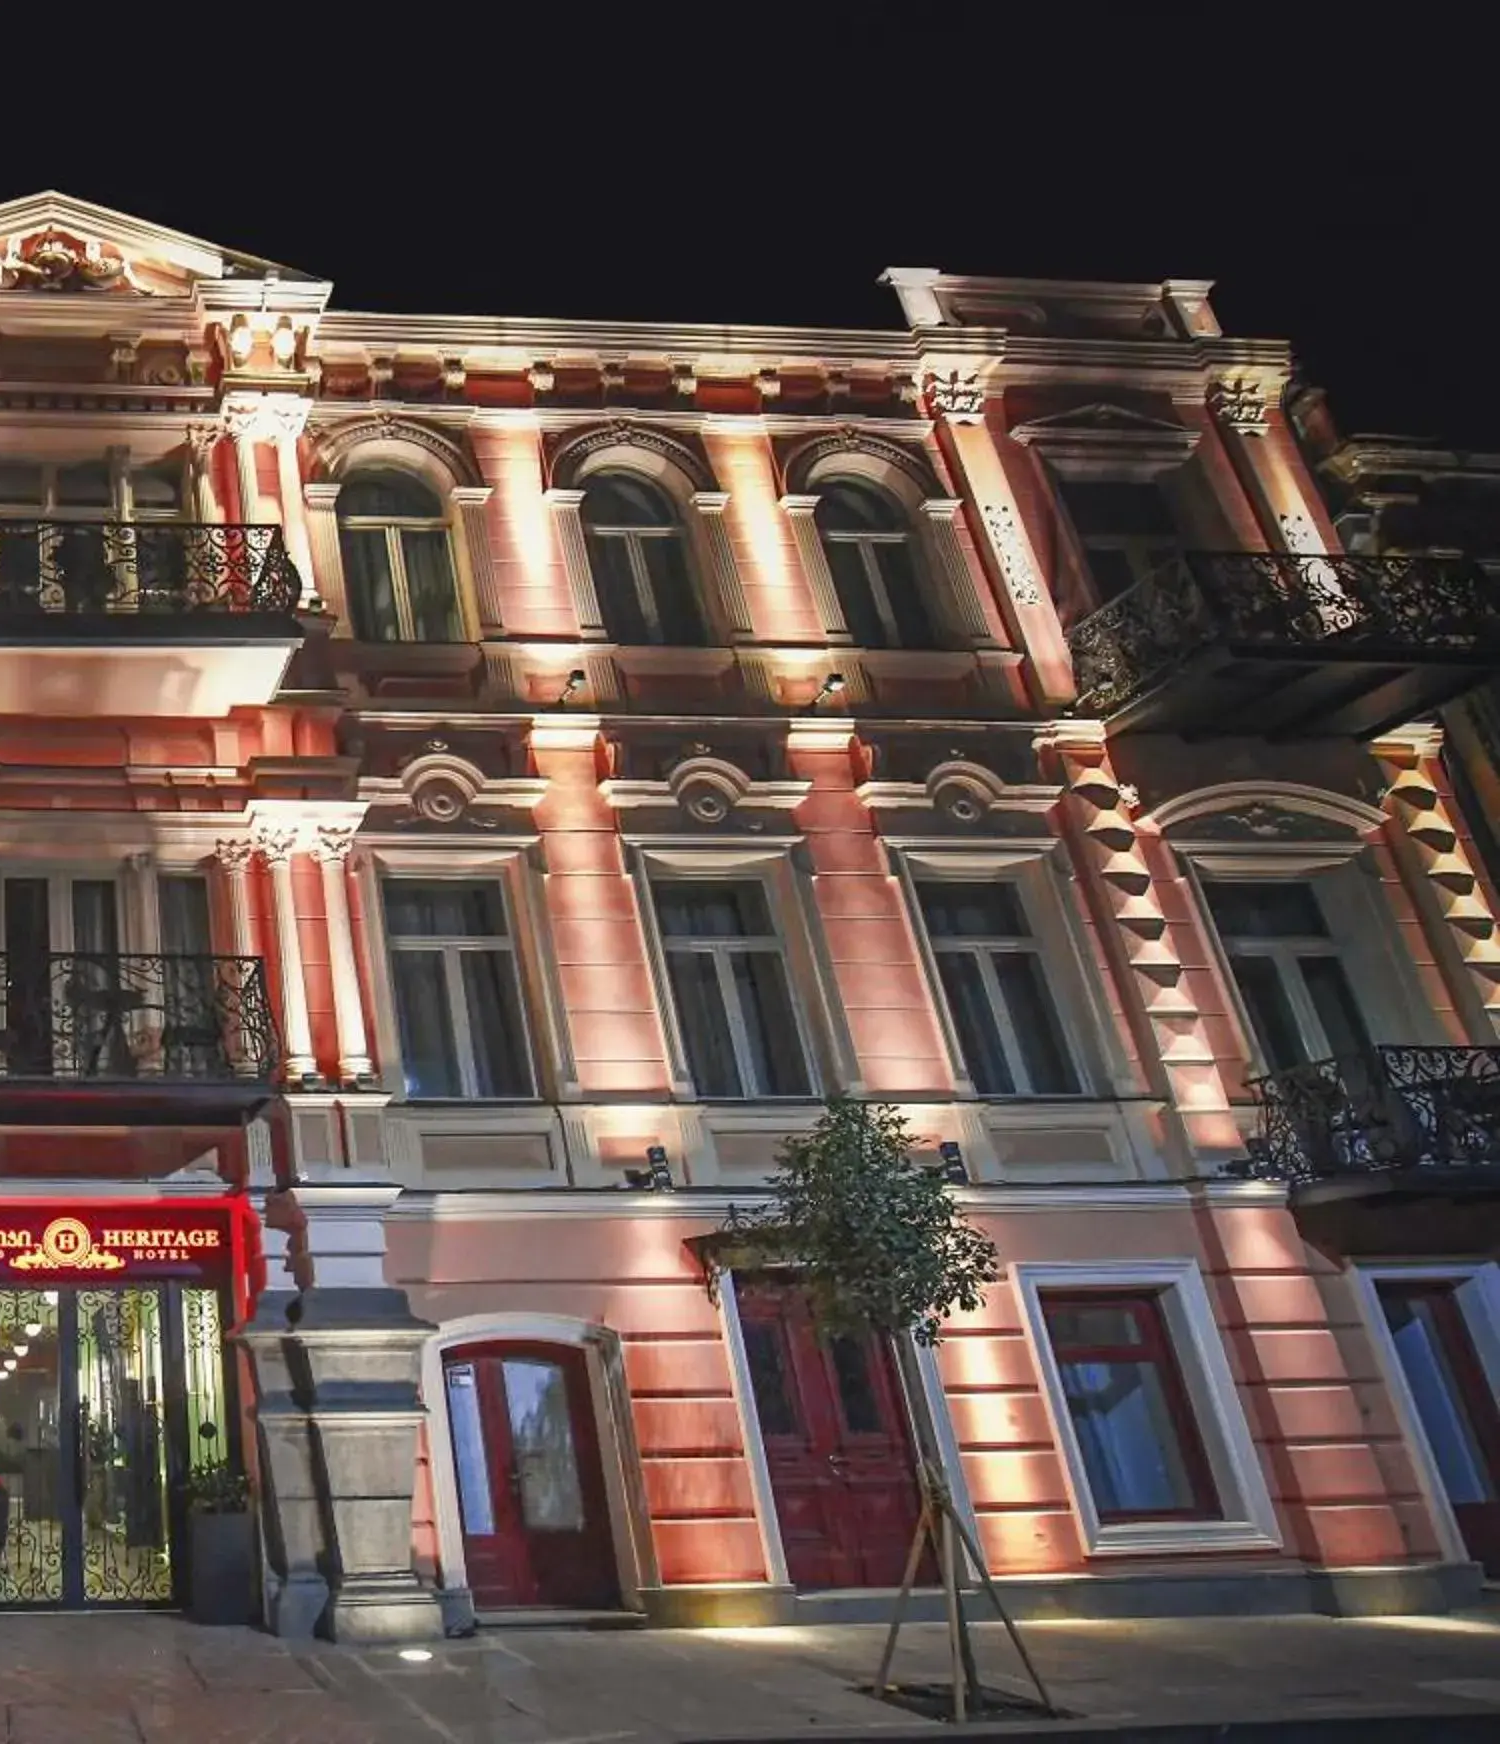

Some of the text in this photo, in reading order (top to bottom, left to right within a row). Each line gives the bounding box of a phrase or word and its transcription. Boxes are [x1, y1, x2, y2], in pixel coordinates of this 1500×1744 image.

[59, 1233, 76, 1250] H
[103, 1229, 220, 1247] HERITAGE
[133, 1249, 190, 1260] HOTEL
